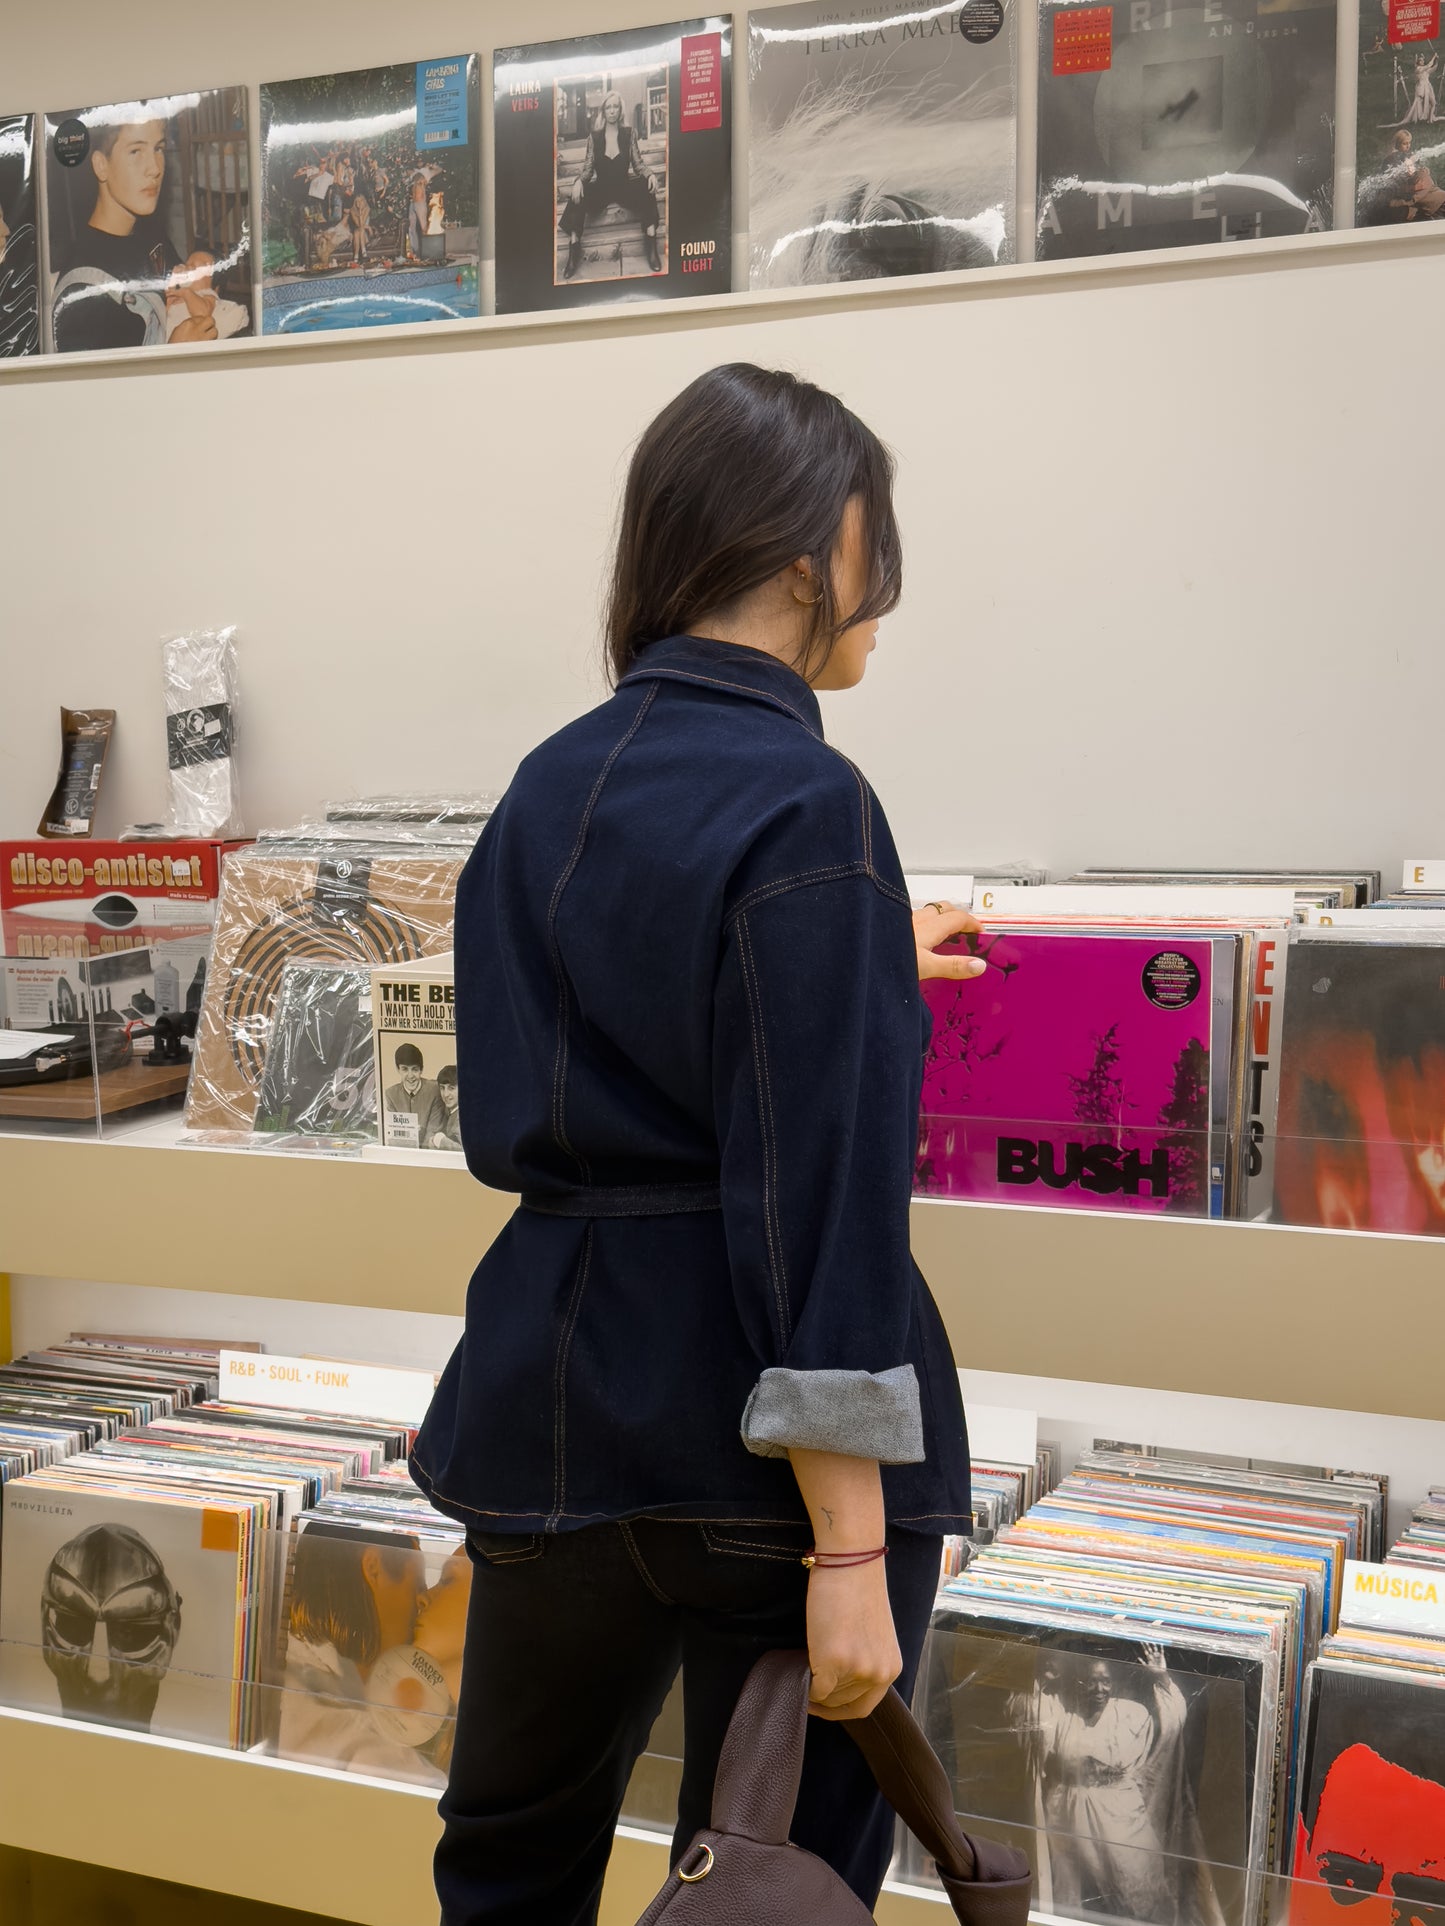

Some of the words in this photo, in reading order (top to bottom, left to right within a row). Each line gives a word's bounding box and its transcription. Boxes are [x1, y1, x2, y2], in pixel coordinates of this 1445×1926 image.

[861, 5, 889, 15] JULES
[510, 80, 541, 97] LAURA
[511, 97, 540, 112] VEIRS
[680, 240, 716, 257] FOUND
[682, 257, 714, 273] LIGHT
[11, 853, 203, 887] disco-antistat
[1414, 866, 1425, 883] E
[983, 892, 994, 908] C
[380, 983, 420, 1002] THE
[385, 1003, 408, 1017] WANT
[411, 1004, 421, 1018] TO
[424, 1005, 445, 1019] HOLD
[384, 1017, 397, 1027] SAW
[399, 1018, 411, 1028] HER
[413, 1019, 443, 1030] STANDING
[997, 1136, 1169, 1198] BUSH
[229, 1360, 256, 1377] R&B
[269, 1364, 302, 1383] SOUL
[314, 1370, 350, 1388] FUNK
[1354, 1570, 1438, 1604] MÚSICA
[411, 1658, 438, 1686] HONEY
[412, 1651, 444, 1684] LOADED
